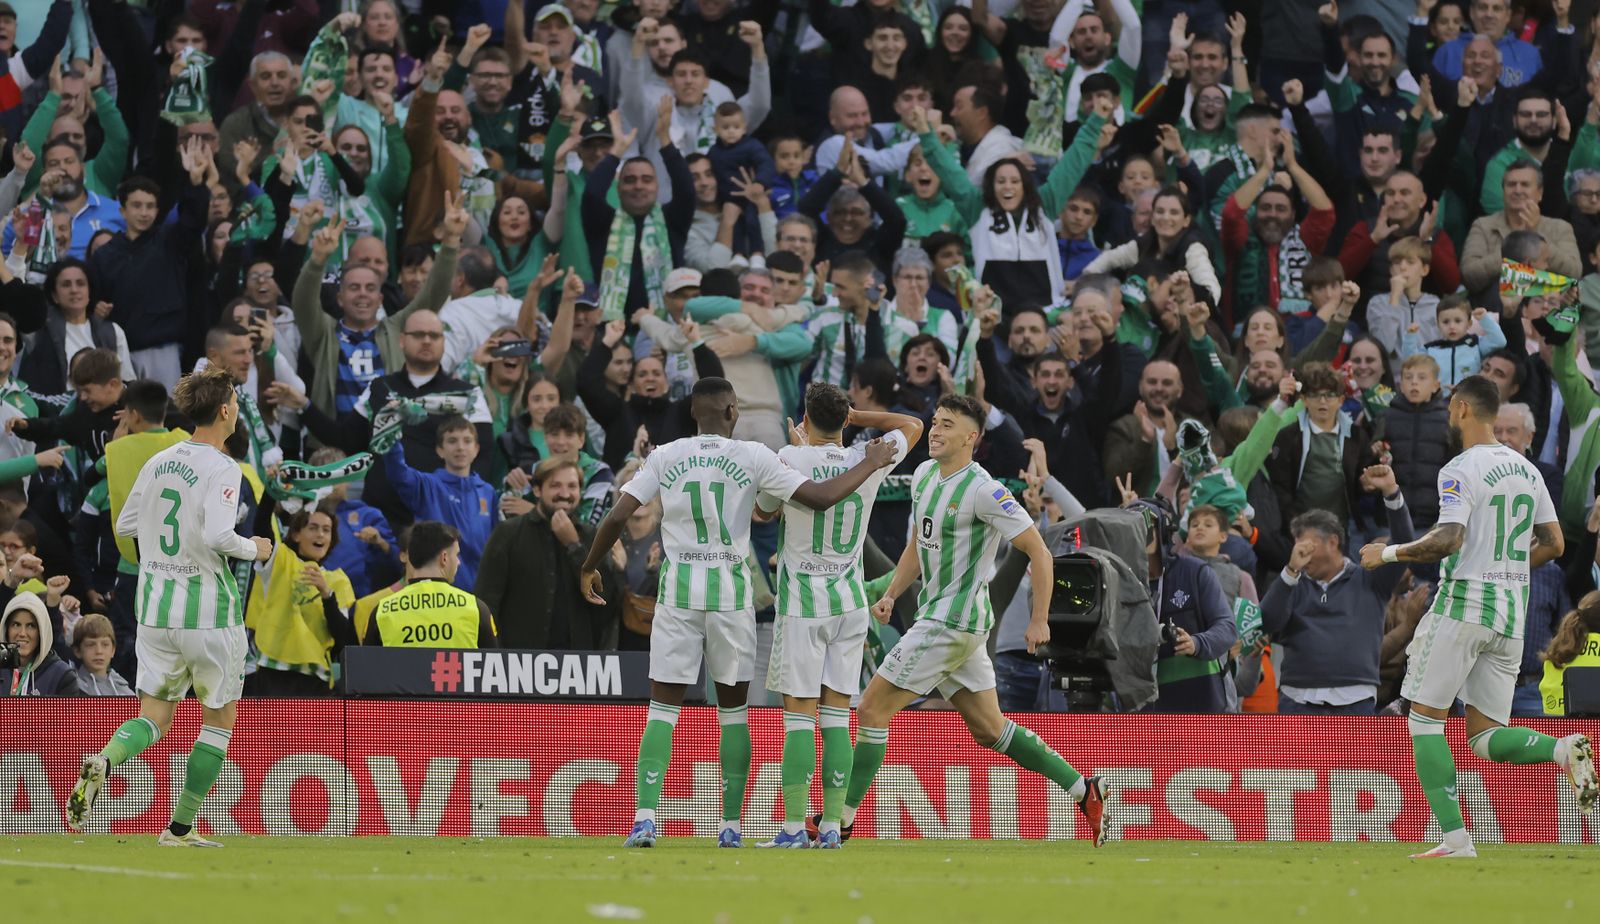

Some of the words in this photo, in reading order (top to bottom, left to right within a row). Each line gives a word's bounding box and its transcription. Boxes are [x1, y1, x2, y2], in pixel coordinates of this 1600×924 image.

[154, 460, 199, 488] MIRANDA
[660, 460, 688, 490] LUIZ
[688, 455, 752, 489] HENRIQUE
[159, 487, 182, 557] 3
[682, 480, 732, 546] 11
[811, 490, 864, 556] 10
[1488, 493, 1535, 562] 12
[679, 551, 718, 562] FOREVER
[381, 592, 467, 614] SEGURIDAD
[402, 622, 453, 644] 2000
[431, 651, 623, 696] #FANCAM
[875, 763, 1505, 843] NUESTRA
